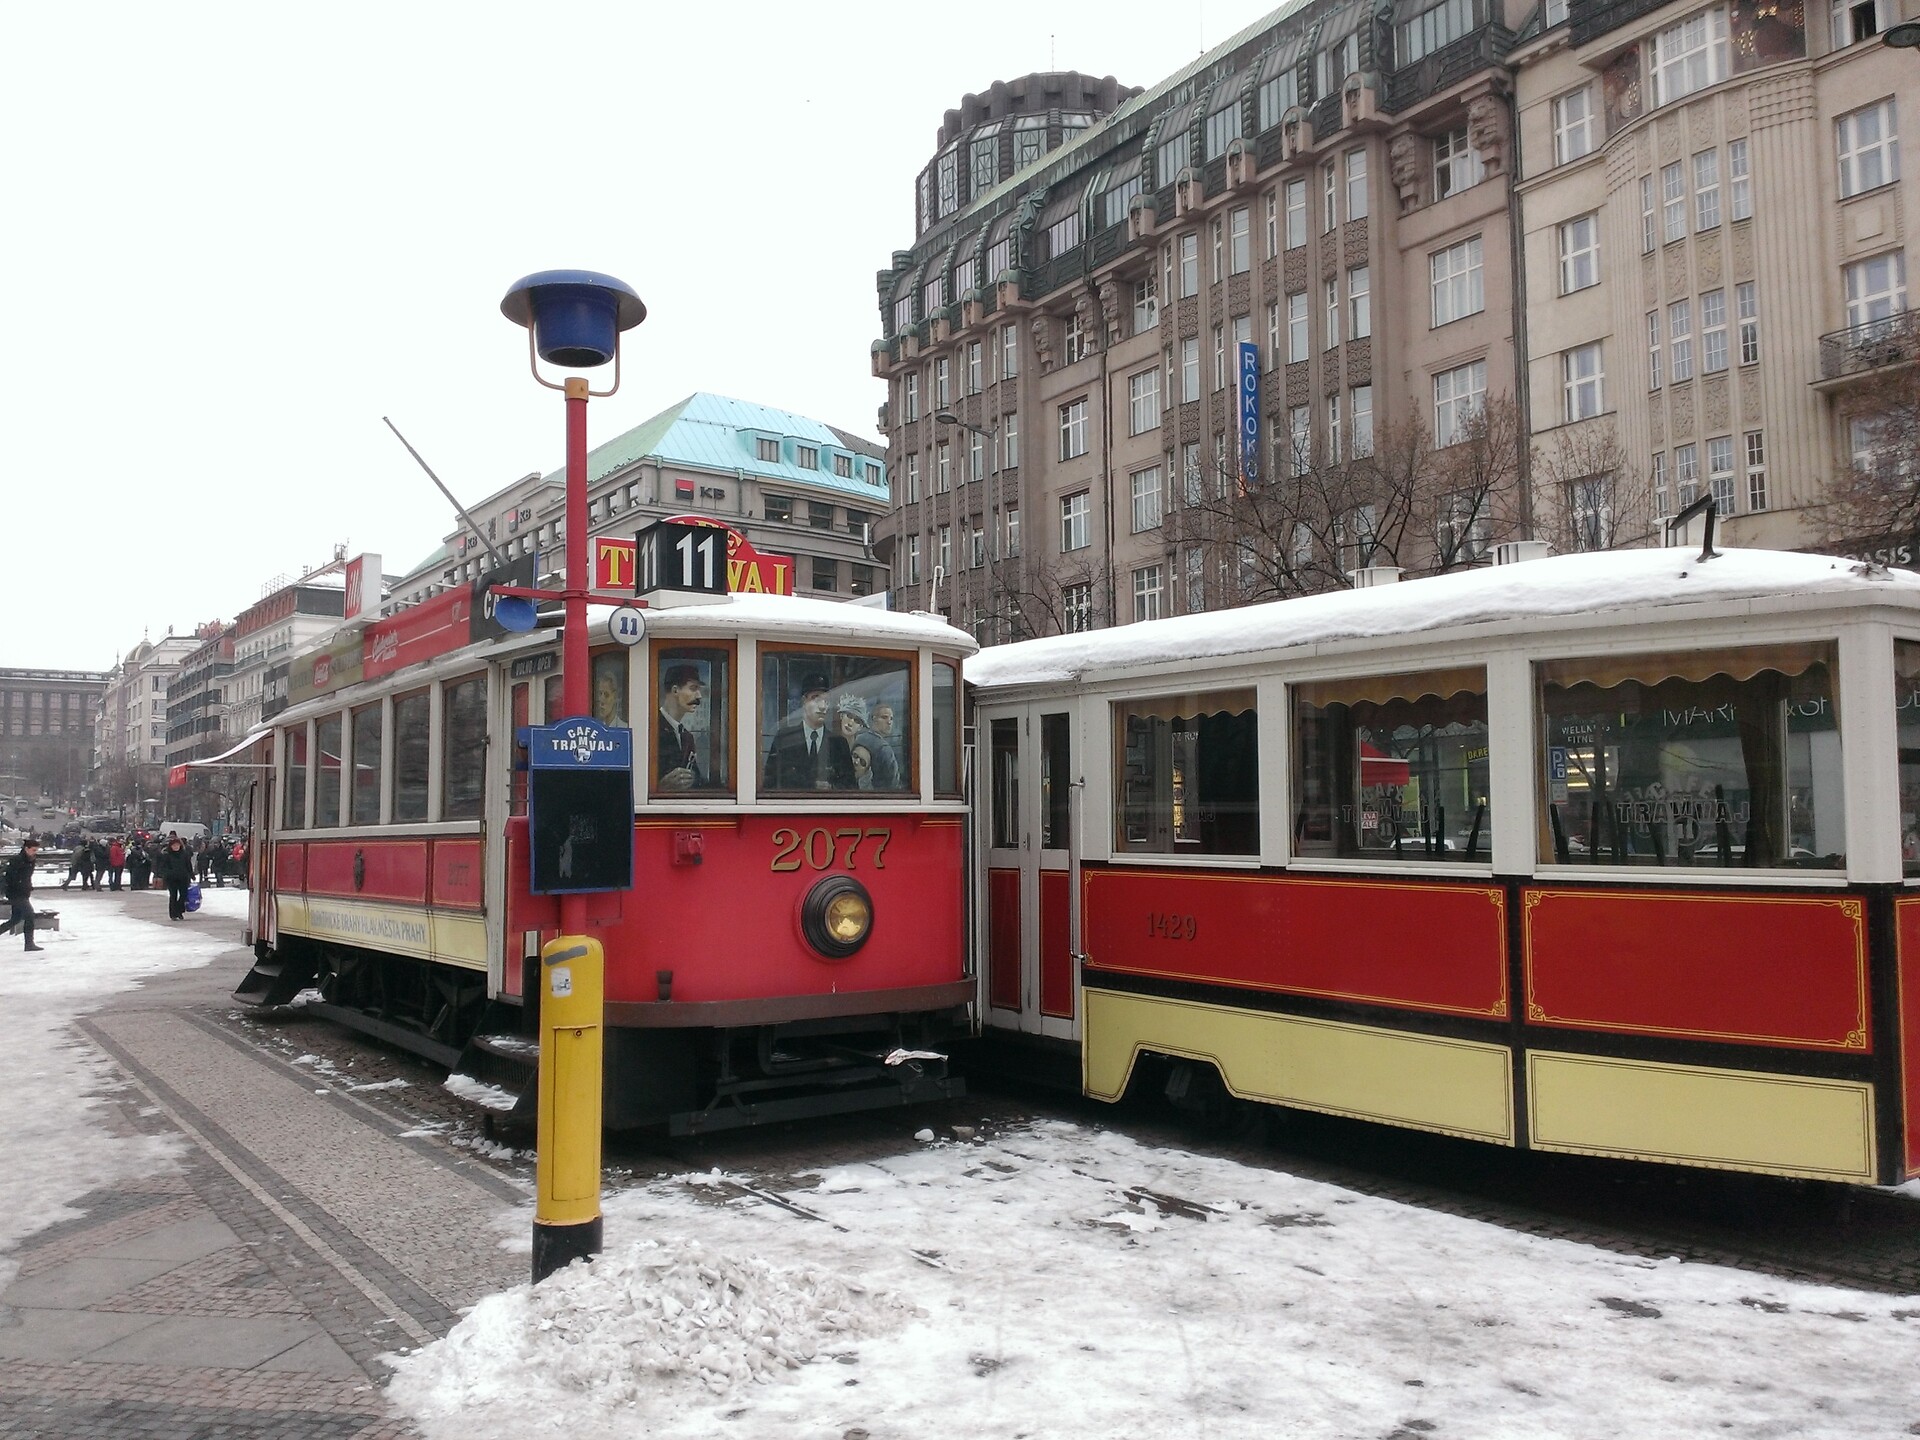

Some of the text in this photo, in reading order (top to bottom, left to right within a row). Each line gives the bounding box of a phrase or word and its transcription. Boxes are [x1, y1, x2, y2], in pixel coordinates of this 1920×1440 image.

[1244, 351, 1258, 478] ROKOKO
[700, 486, 725, 500] KB
[520, 508, 532, 524] KB
[467, 535, 478, 550] KB
[600, 544, 788, 595] TVAJ
[641, 531, 657, 590] 11
[676, 531, 714, 589] 11
[619, 616, 638, 636] 11
[551, 736, 614, 752] TRAMVAJ
[566, 726, 599, 740] CAFE
[1616, 794, 1751, 824] TRAMVAJ
[770, 827, 892, 872] 2077
[1146, 911, 1197, 942] 1429
